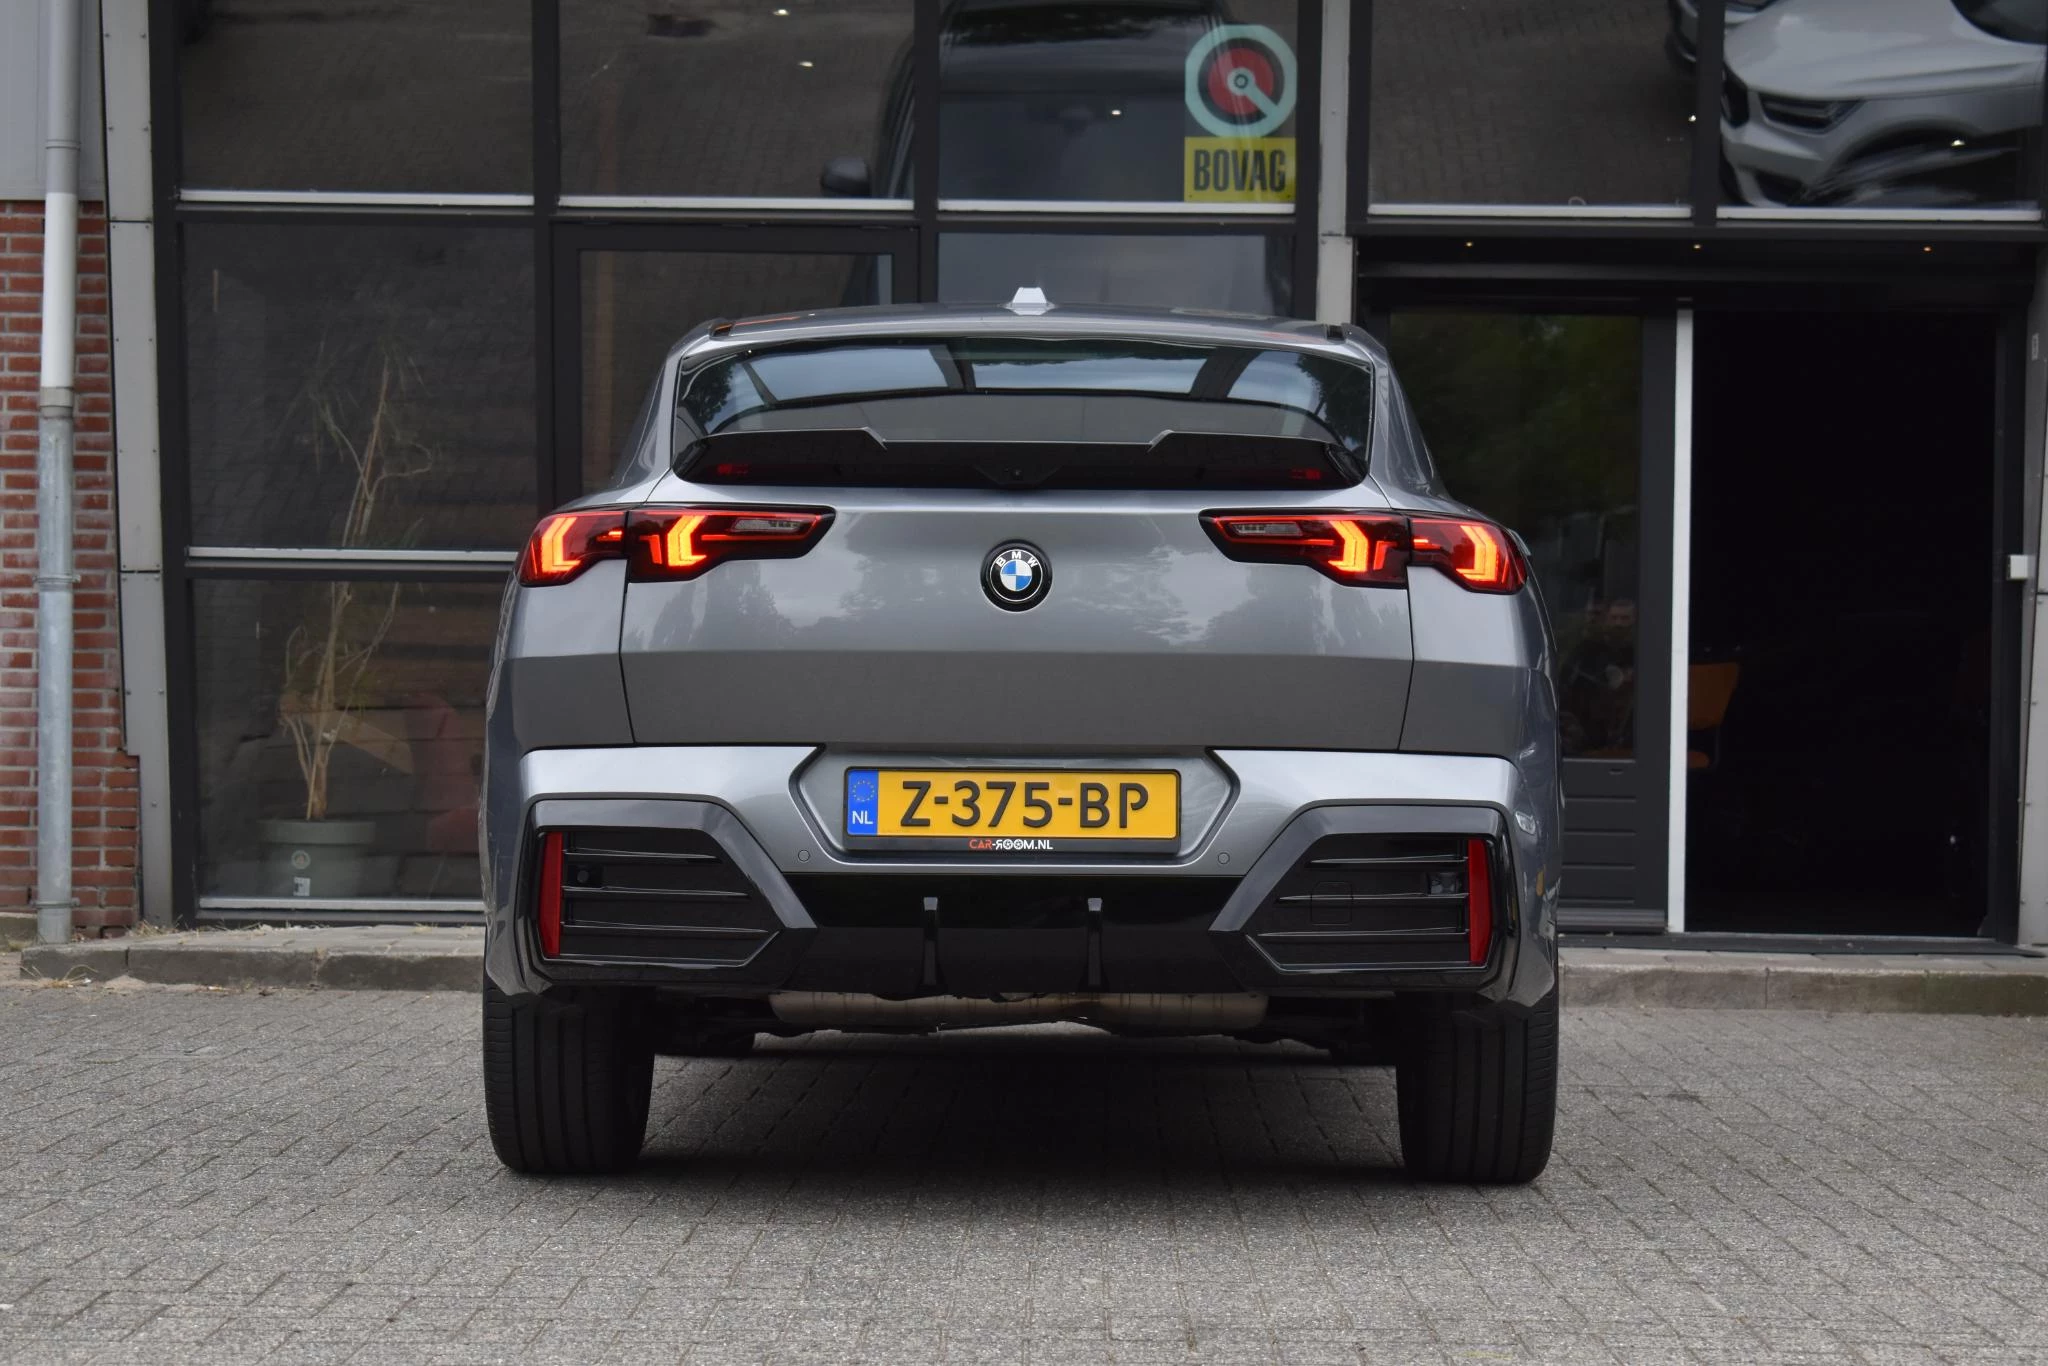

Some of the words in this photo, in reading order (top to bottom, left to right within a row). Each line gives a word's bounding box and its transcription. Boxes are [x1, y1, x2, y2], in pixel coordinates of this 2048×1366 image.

[1194, 148, 1286, 192] BOVAG
[995, 551, 1038, 568] BMW
[852, 810, 873, 825] NL
[900, 780, 1149, 829] Z-375-BP
